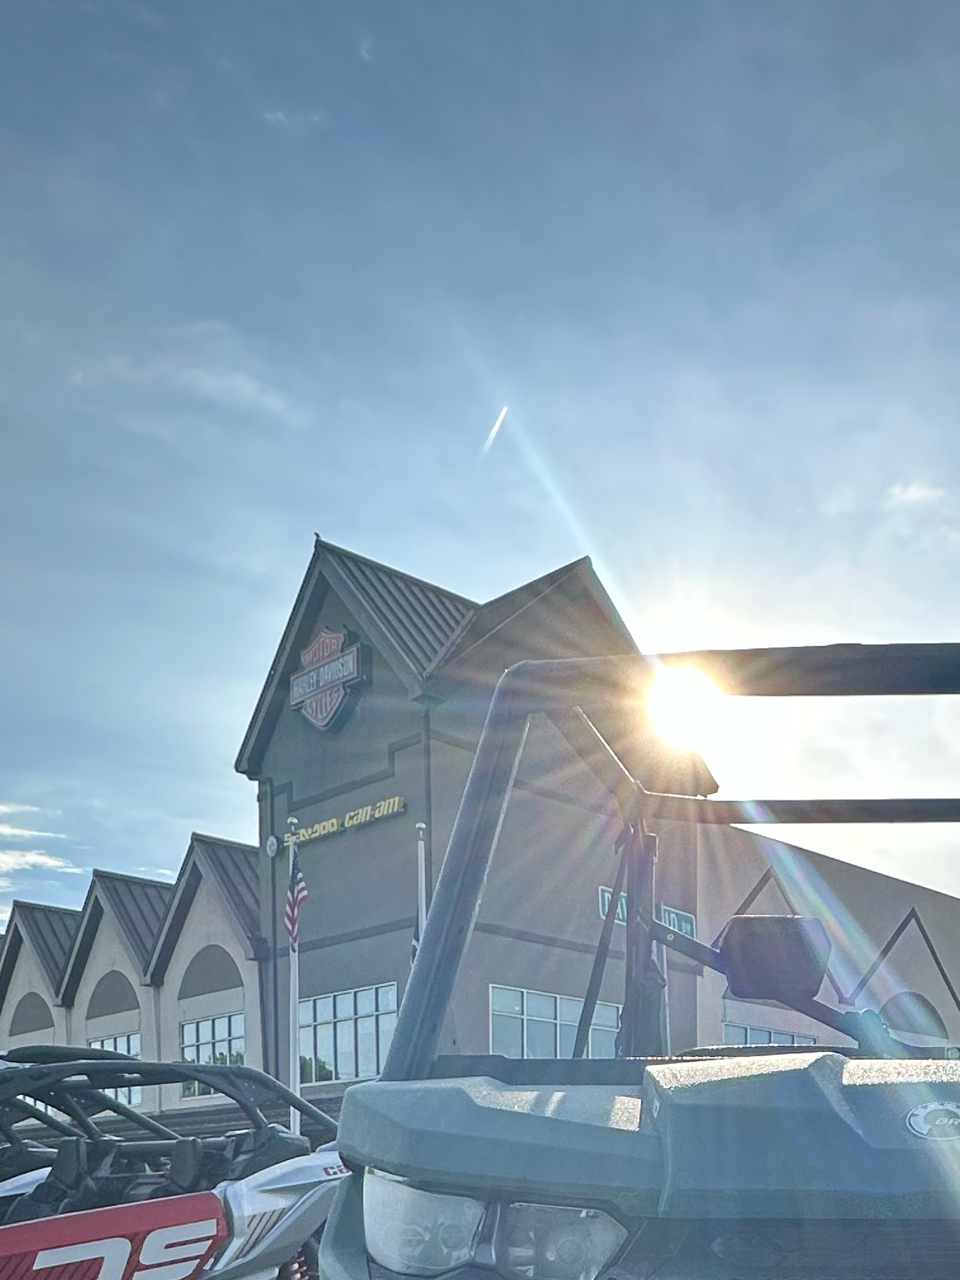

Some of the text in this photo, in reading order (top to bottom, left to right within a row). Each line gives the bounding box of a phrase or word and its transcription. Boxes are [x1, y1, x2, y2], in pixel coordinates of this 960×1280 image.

[302, 638, 340, 669] MOTOR
[293, 651, 355, 701] HARLEY-DAVIDSON
[307, 686, 341, 720] CYCLES
